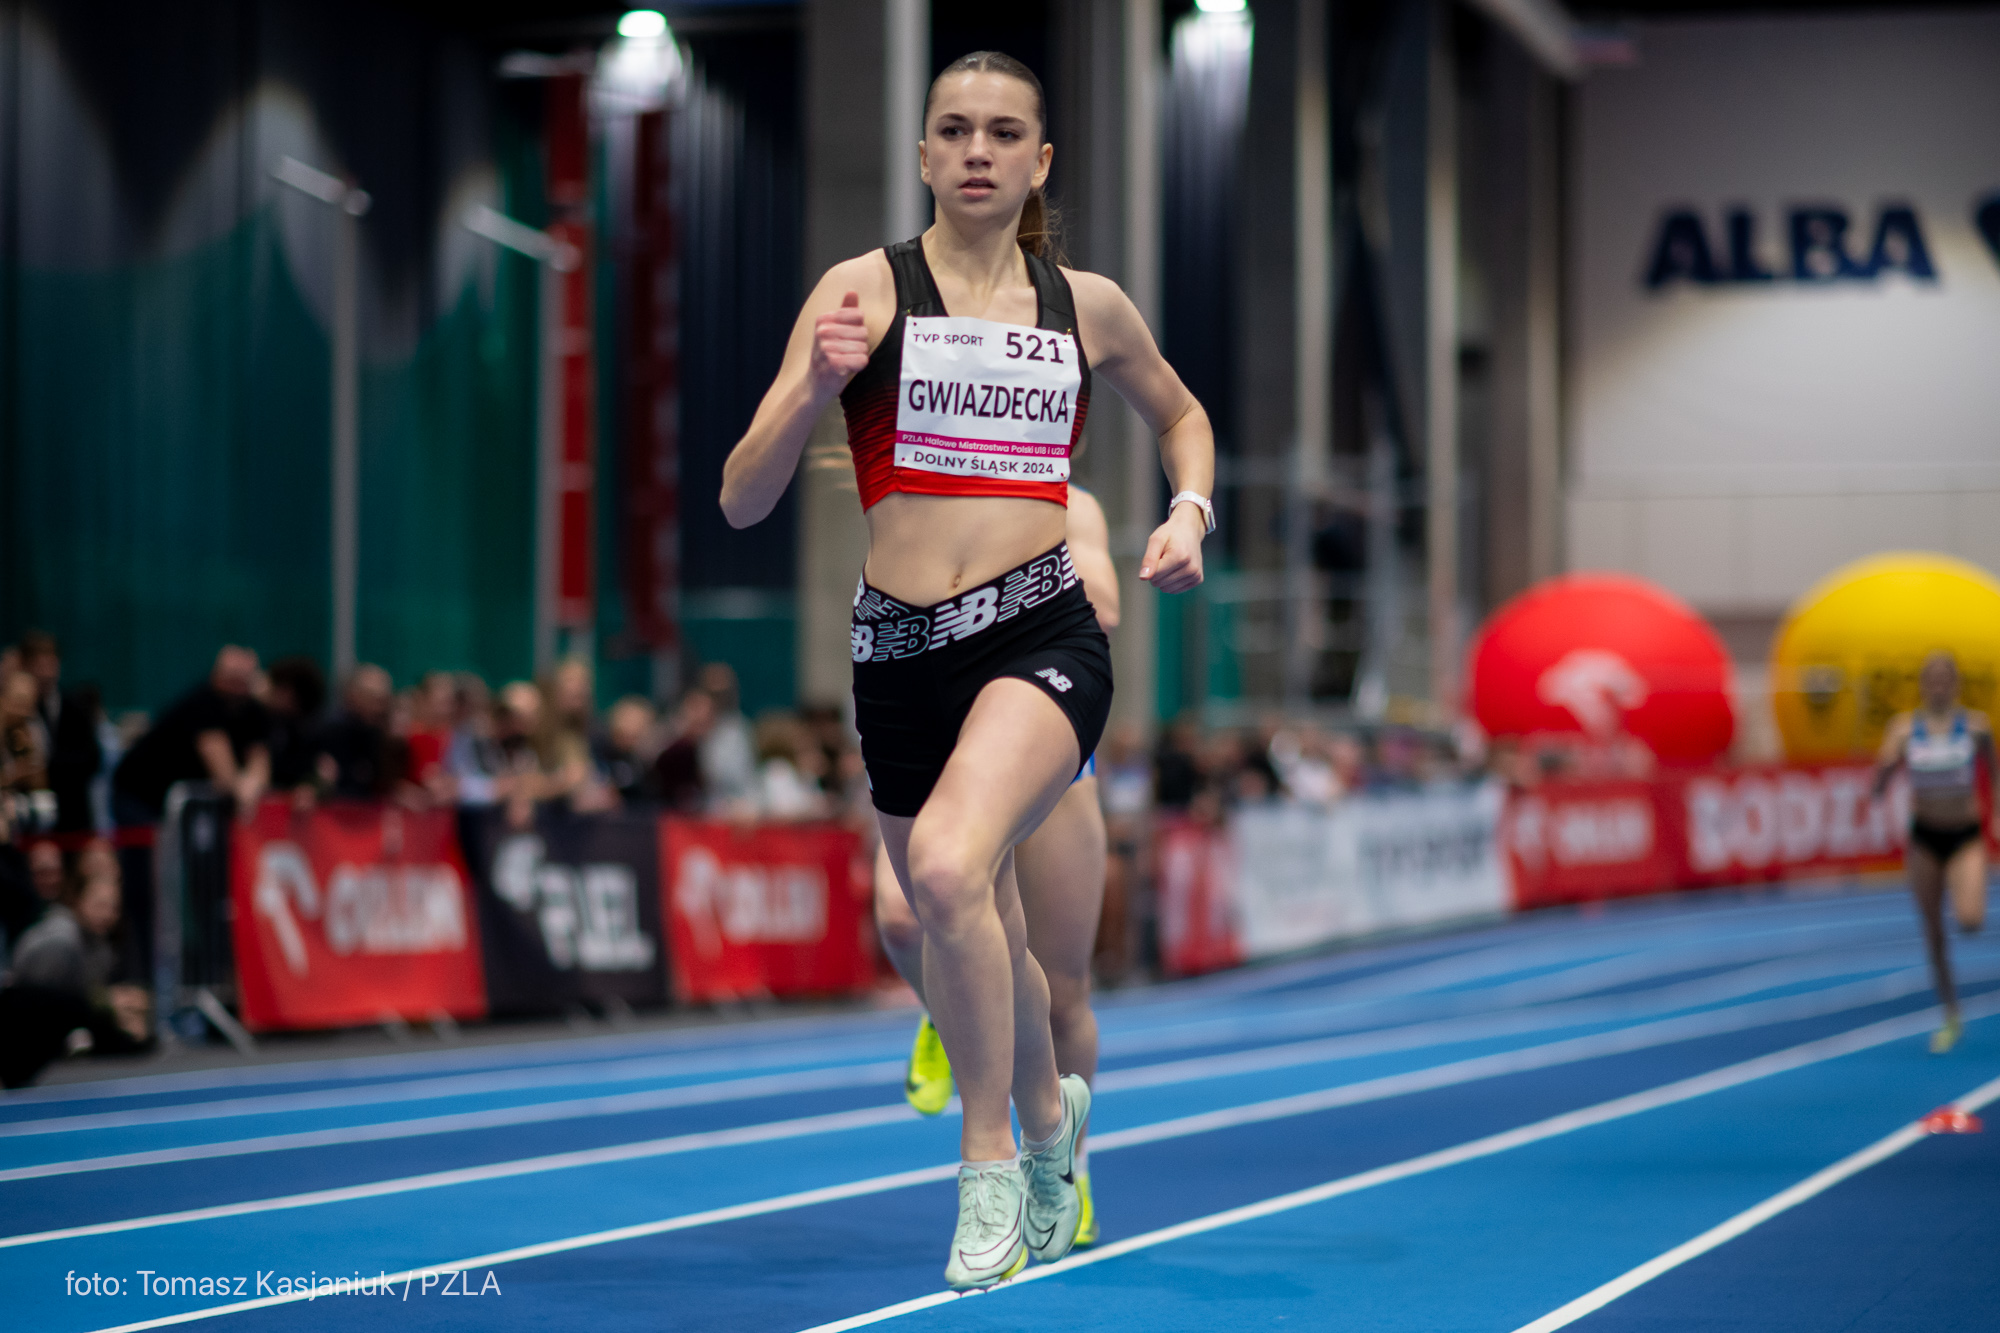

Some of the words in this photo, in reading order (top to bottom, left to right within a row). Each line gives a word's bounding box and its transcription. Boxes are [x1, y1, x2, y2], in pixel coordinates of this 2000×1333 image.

[1647, 200, 1940, 287] ALBA
[913, 333, 940, 343] TVP
[944, 334, 984, 346] SPORT
[1005, 331, 1064, 364] 521
[908, 379, 1068, 423] GWIAZDECKA
[902, 433, 923, 443] PZLA
[924, 436, 957, 448] Halowe
[958, 441, 1010, 453] Mistrzostwa
[1011, 444, 1033, 454] Polski
[1034, 446, 1046, 455] U18
[1051, 447, 1066, 456] U20
[913, 451, 967, 469] DOLNY
[970, 456, 1019, 474] ŚLĄSK
[1022, 461, 1055, 475] 2024
[928, 586, 999, 651] NB
[1035, 667, 1073, 692] NB
